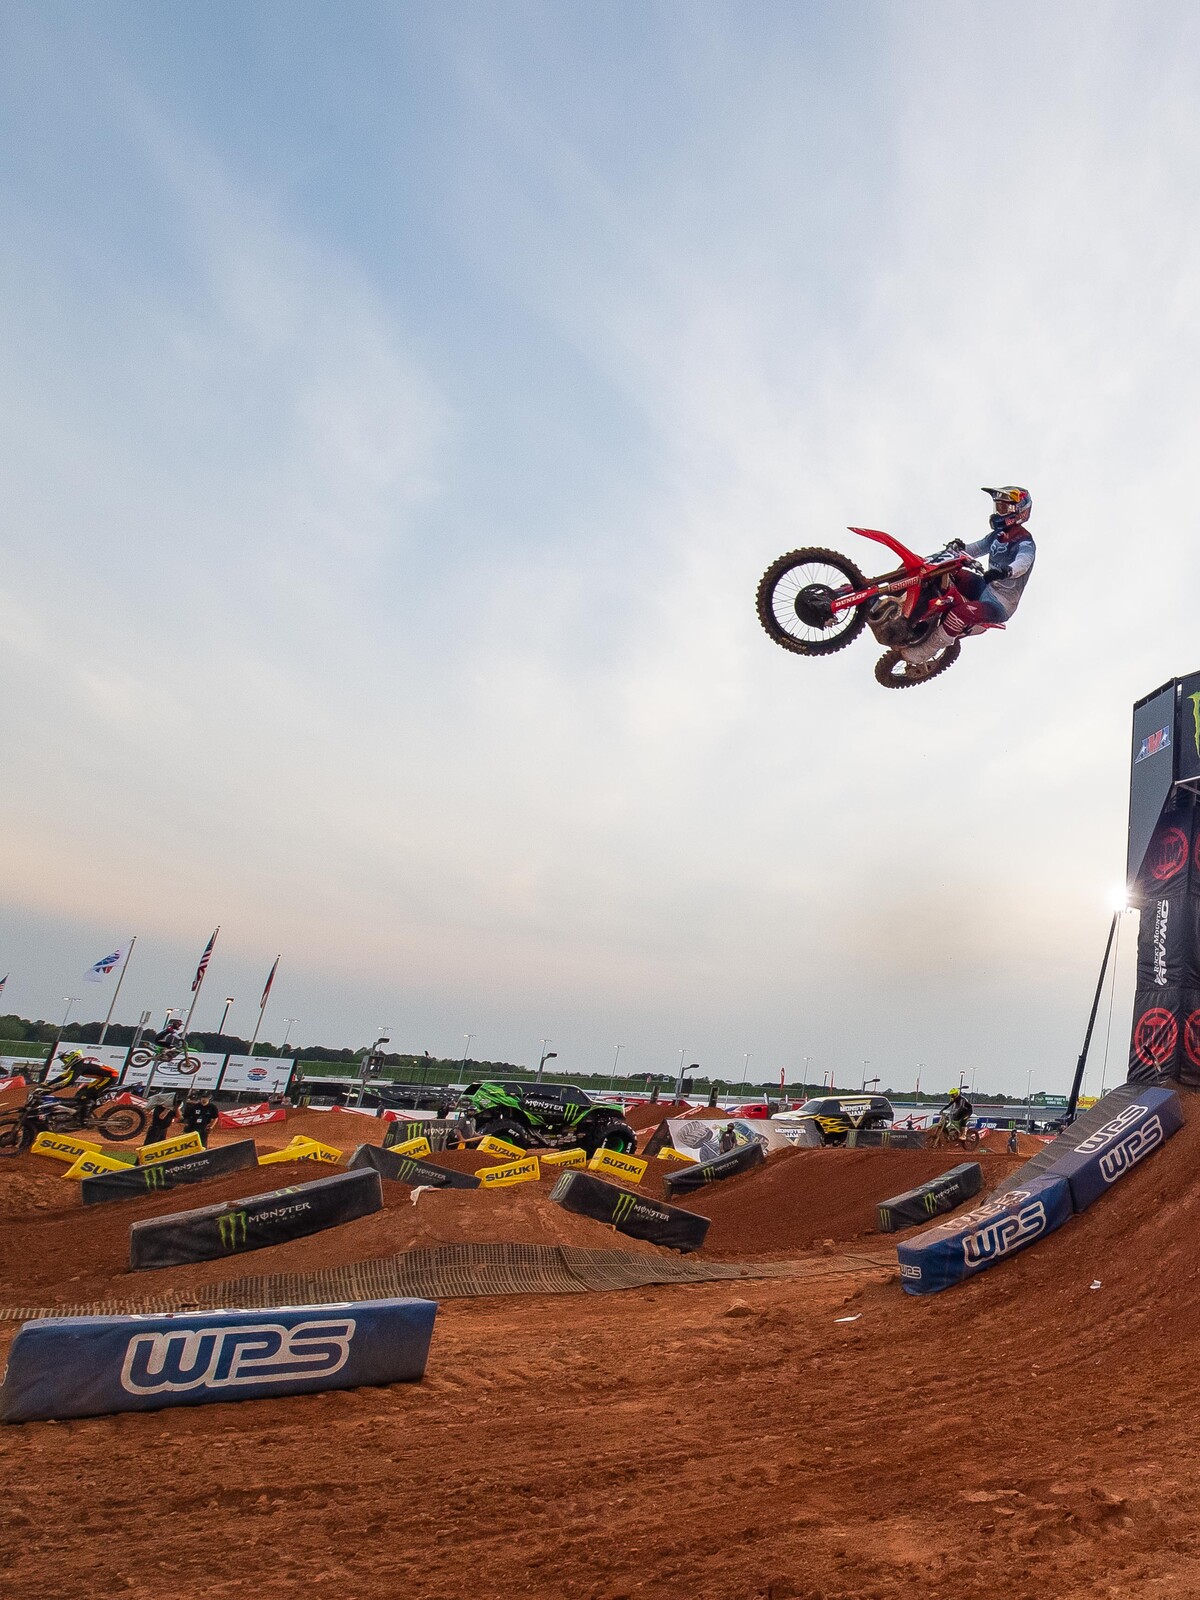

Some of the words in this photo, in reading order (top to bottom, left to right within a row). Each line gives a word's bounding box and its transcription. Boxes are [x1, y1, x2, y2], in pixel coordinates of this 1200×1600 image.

[835, 591, 867, 607] DUNLOP
[1153, 900, 1162, 945] MOUNTAIN
[524, 1100, 564, 1113] MONSTER
[840, 1104, 872, 1112] MONSTER
[1073, 1104, 1148, 1154] WPS
[144, 1139, 199, 1162] SUZUKI
[487, 1143, 522, 1160] SUZUKI
[1099, 1114, 1163, 1183] WPS
[165, 1159, 210, 1176] MONSTER
[415, 1167, 447, 1180] MONSTER
[485, 1163, 535, 1182] SUZUKI
[602, 1157, 643, 1175] SUZUKI
[714, 1159, 739, 1171] MONSTER
[248, 1200, 311, 1226] MONSTER
[633, 1204, 670, 1222] MONSTER
[962, 1200, 1047, 1267] WPS
[120, 1318, 357, 1396] WPS
